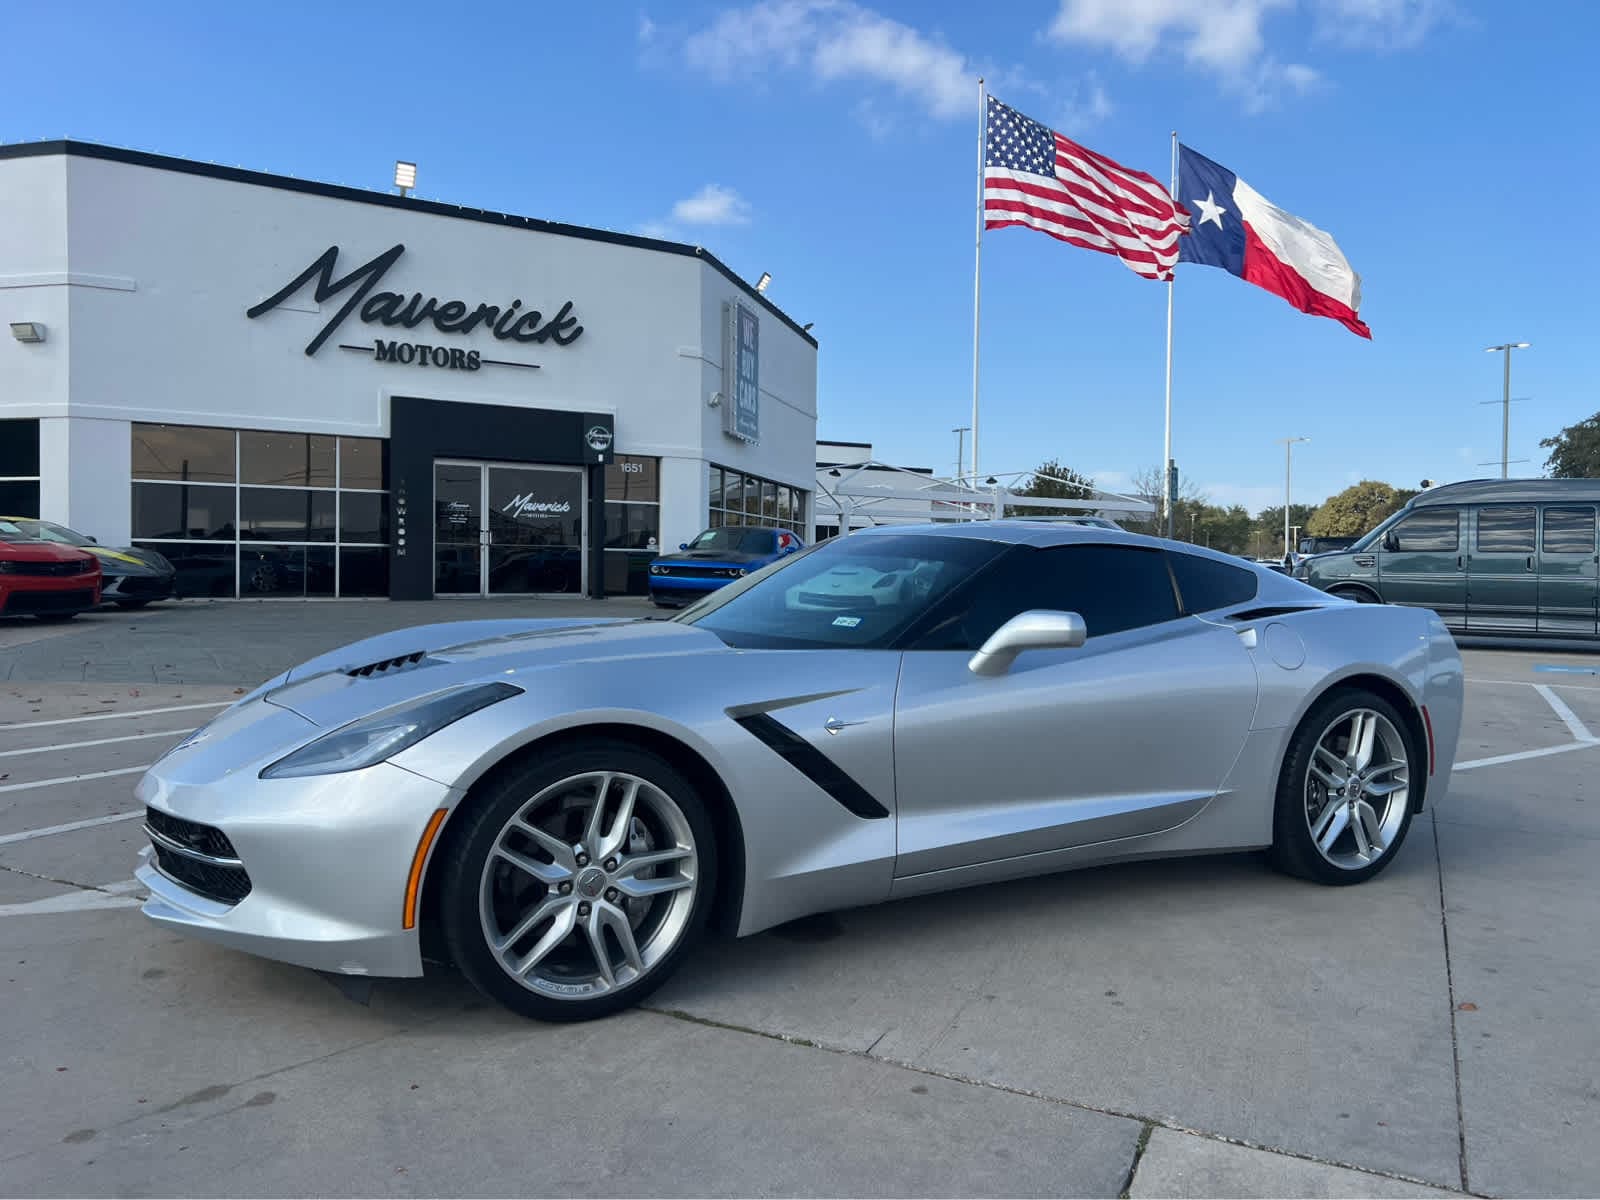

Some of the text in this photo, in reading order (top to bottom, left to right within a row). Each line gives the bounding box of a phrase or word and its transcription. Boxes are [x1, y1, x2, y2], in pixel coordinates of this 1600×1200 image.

[247, 243, 584, 356] Maverick
[374, 339, 481, 371] MOTORS
[620, 463, 643, 473] 1651
[396, 479, 407, 556] OWROOM
[502, 492, 570, 518] Maverick
